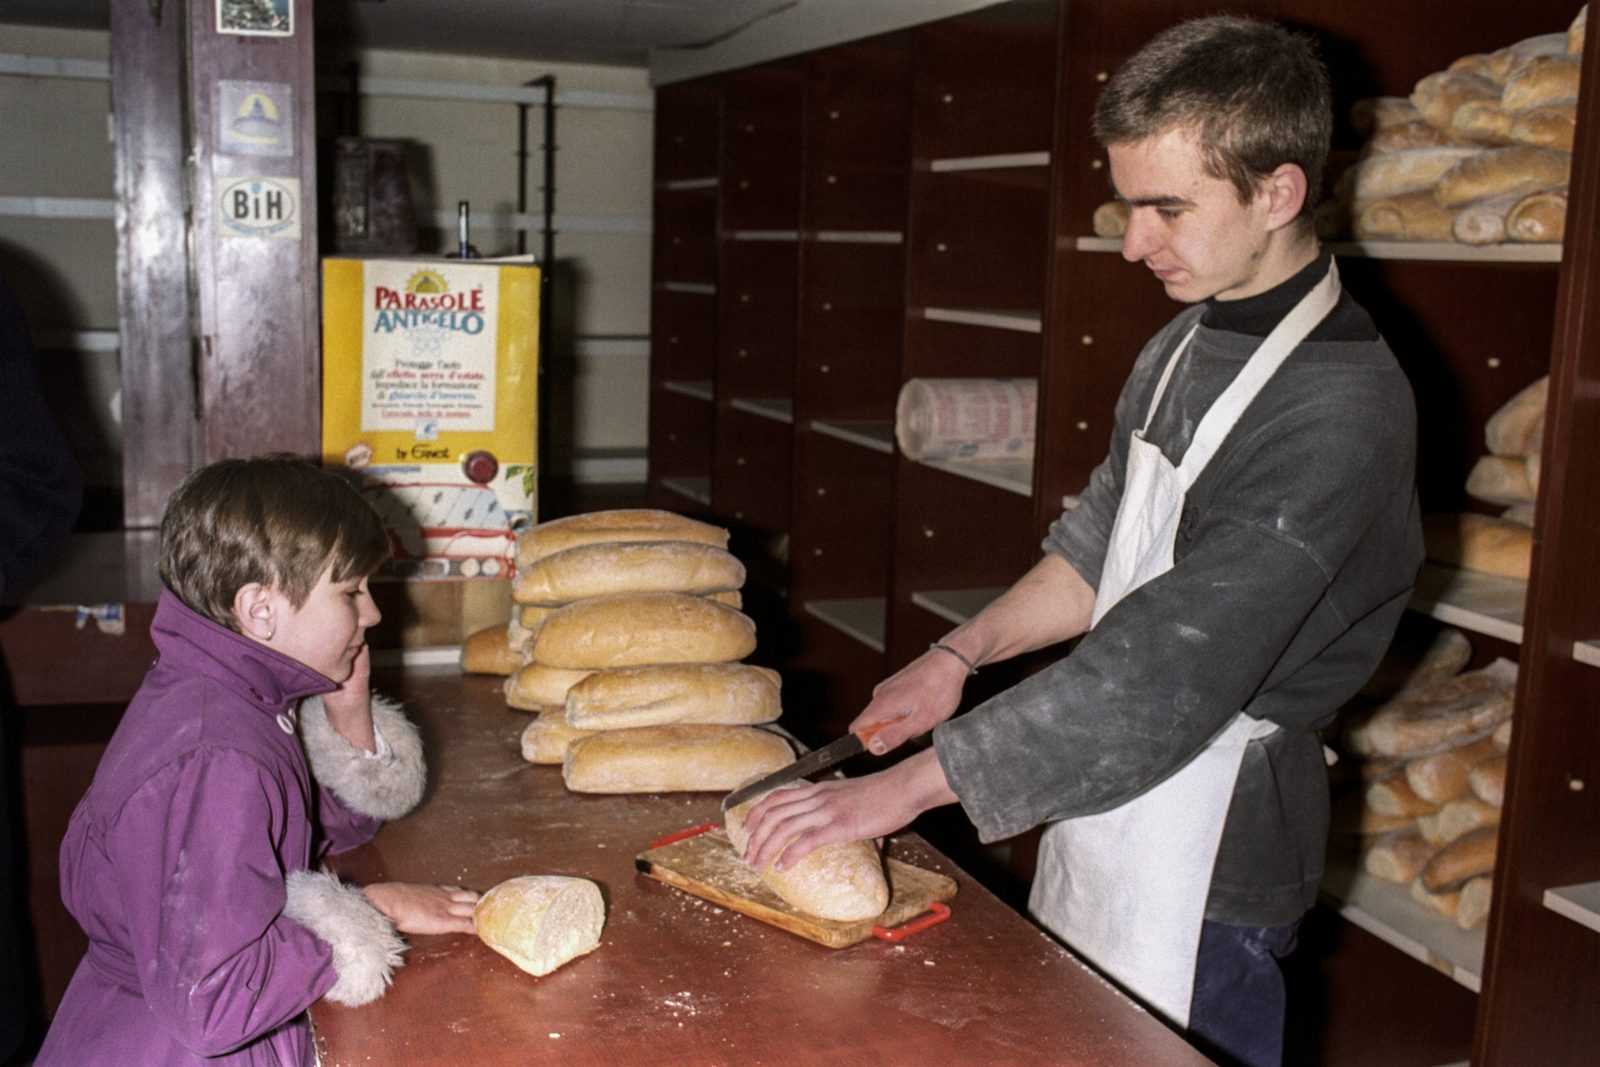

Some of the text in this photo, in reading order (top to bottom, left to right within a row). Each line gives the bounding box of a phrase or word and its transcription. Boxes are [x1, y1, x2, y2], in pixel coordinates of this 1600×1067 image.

[234, 185, 282, 219] BiH
[374, 286, 485, 311] PARASOLE
[373, 308, 485, 335] ANTIGELO
[396, 448, 407, 460] by
